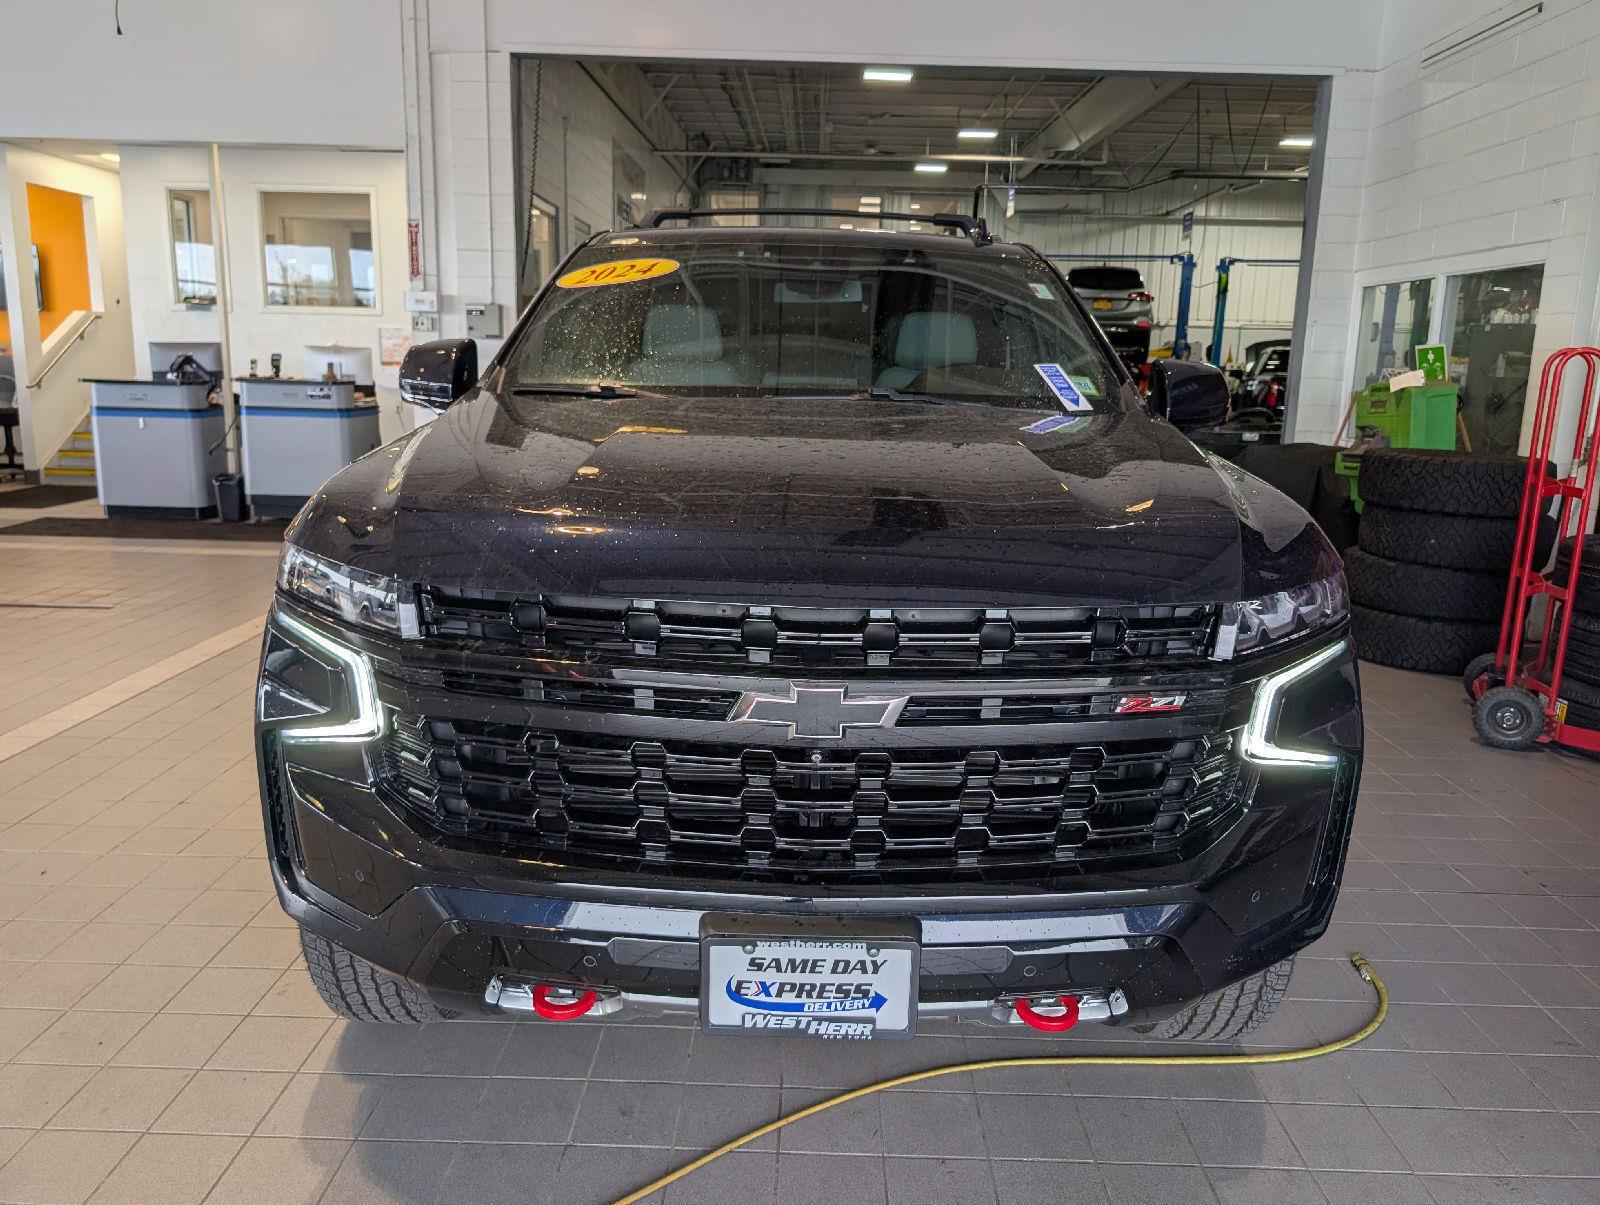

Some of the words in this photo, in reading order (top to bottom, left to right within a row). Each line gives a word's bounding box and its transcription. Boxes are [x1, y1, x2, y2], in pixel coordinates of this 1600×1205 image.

[572, 261, 661, 286] 2024
[1115, 695, 1187, 713] Z71
[756, 940, 867, 950] westherr.com
[746, 956, 827, 974] SAME
[830, 959, 888, 975] DAY
[734, 979, 874, 1000] EXPRESS
[803, 997, 873, 1013] DELIVERY
[743, 1013, 813, 1029] WEST
[807, 1021, 874, 1035] HERR
